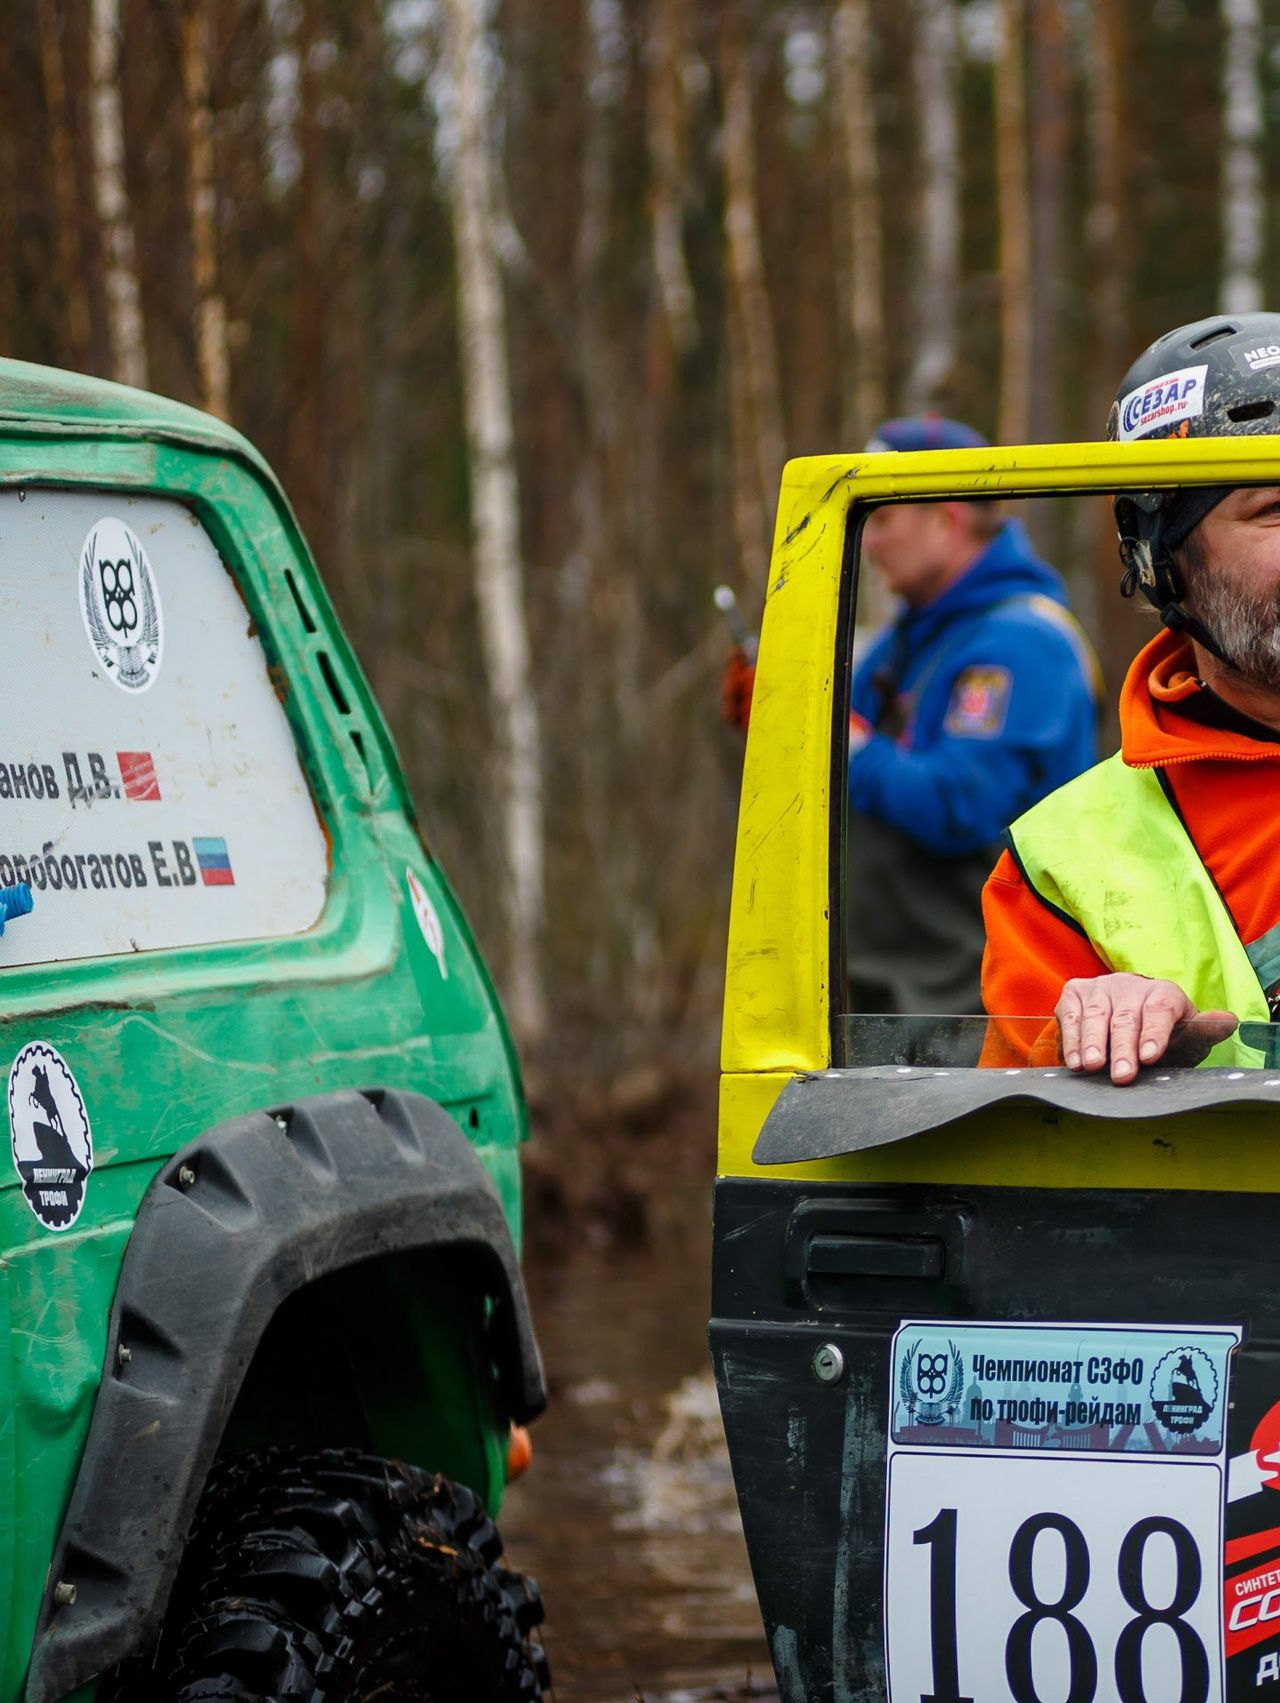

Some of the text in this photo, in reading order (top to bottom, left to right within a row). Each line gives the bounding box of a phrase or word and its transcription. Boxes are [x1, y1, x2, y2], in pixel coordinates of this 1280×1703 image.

[1243, 345, 1280, 362] NEO
[1127, 379, 1197, 427] СЕЗАР
[1140, 401, 1187, 426] sezarshop.ru
[38, 1190, 69, 1206] ТРОФИ
[972, 1354, 1144, 1386] Чемпионат СЗФО
[970, 1395, 1142, 1429] по трофи-рейдам
[912, 1508, 1210, 1703] 188
